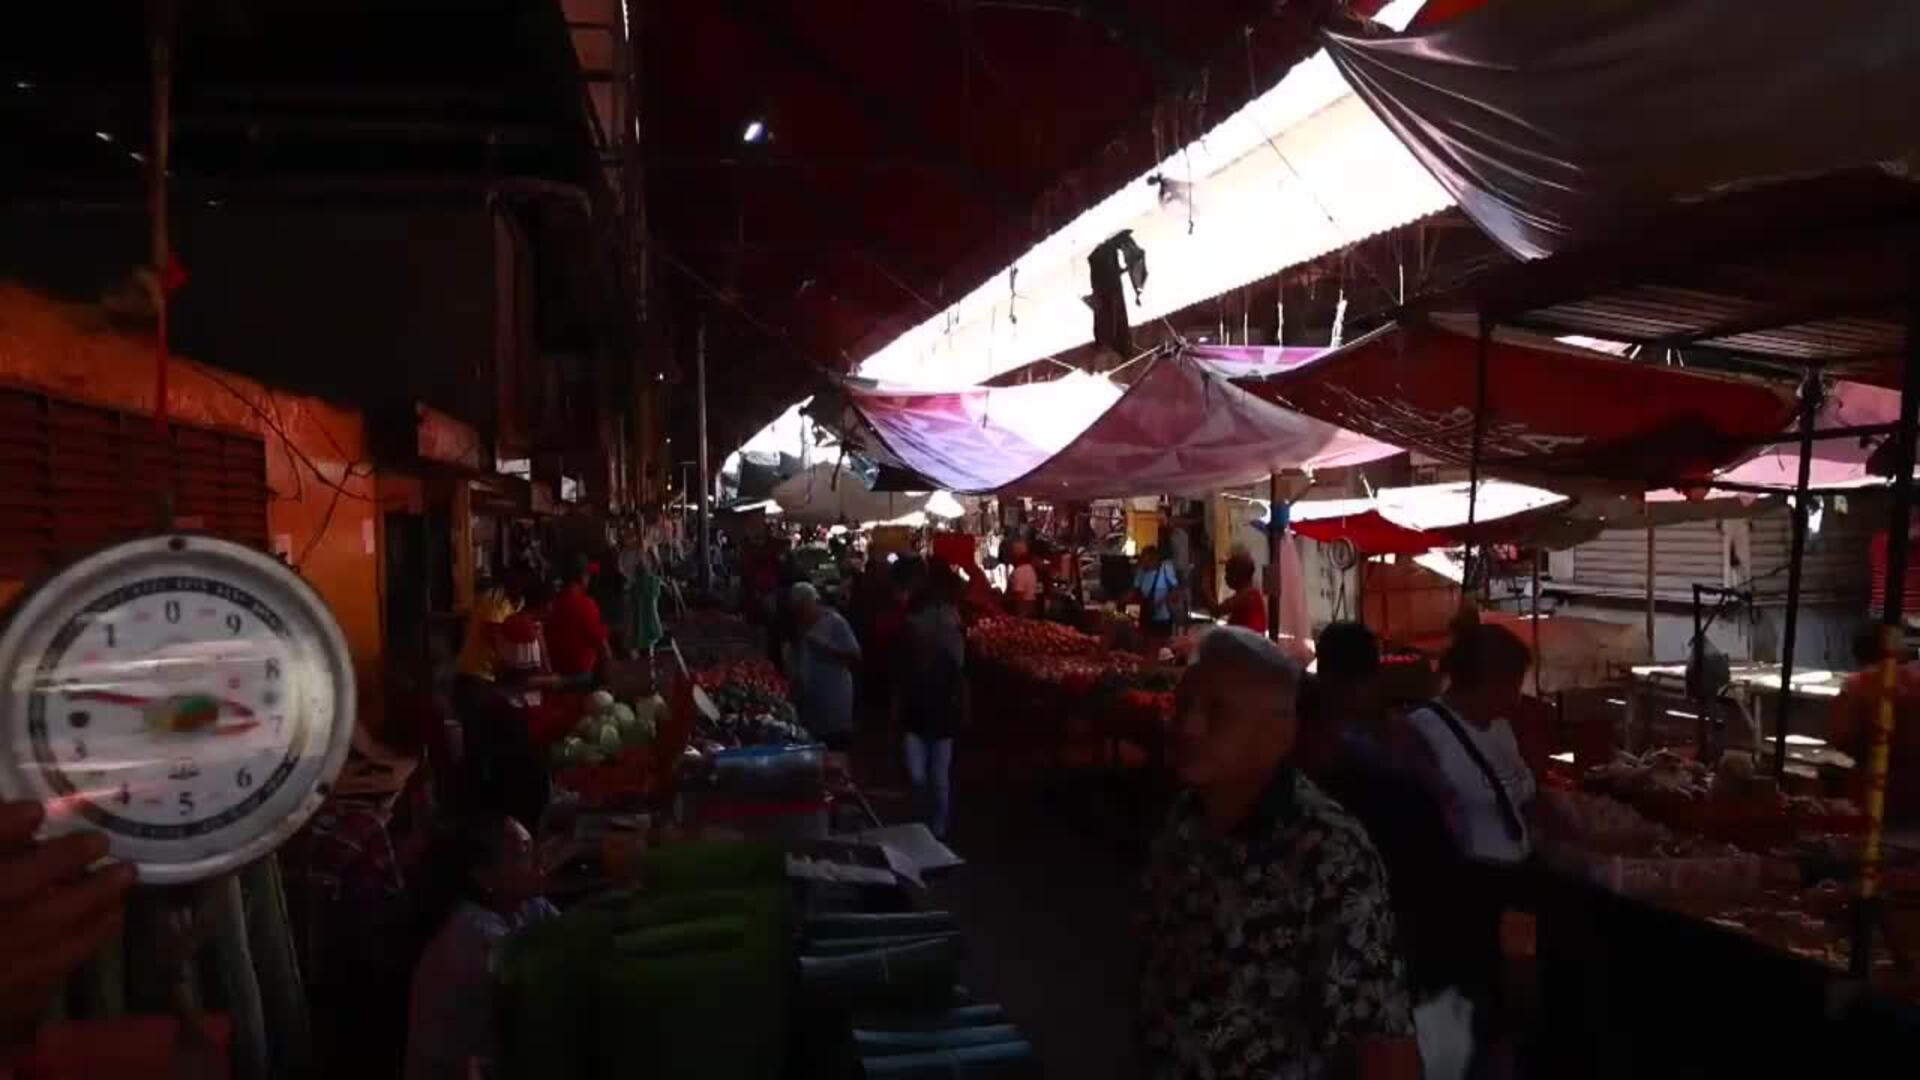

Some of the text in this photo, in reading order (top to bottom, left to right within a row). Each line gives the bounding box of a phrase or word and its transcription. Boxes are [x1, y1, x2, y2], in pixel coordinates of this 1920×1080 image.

[165, 600, 181, 625] 0
[226, 613, 243, 636] 9
[104, 622, 117, 649] 1
[269, 714, 284, 737] 7
[236, 764, 253, 789] 6
[178, 791, 195, 816] 5
